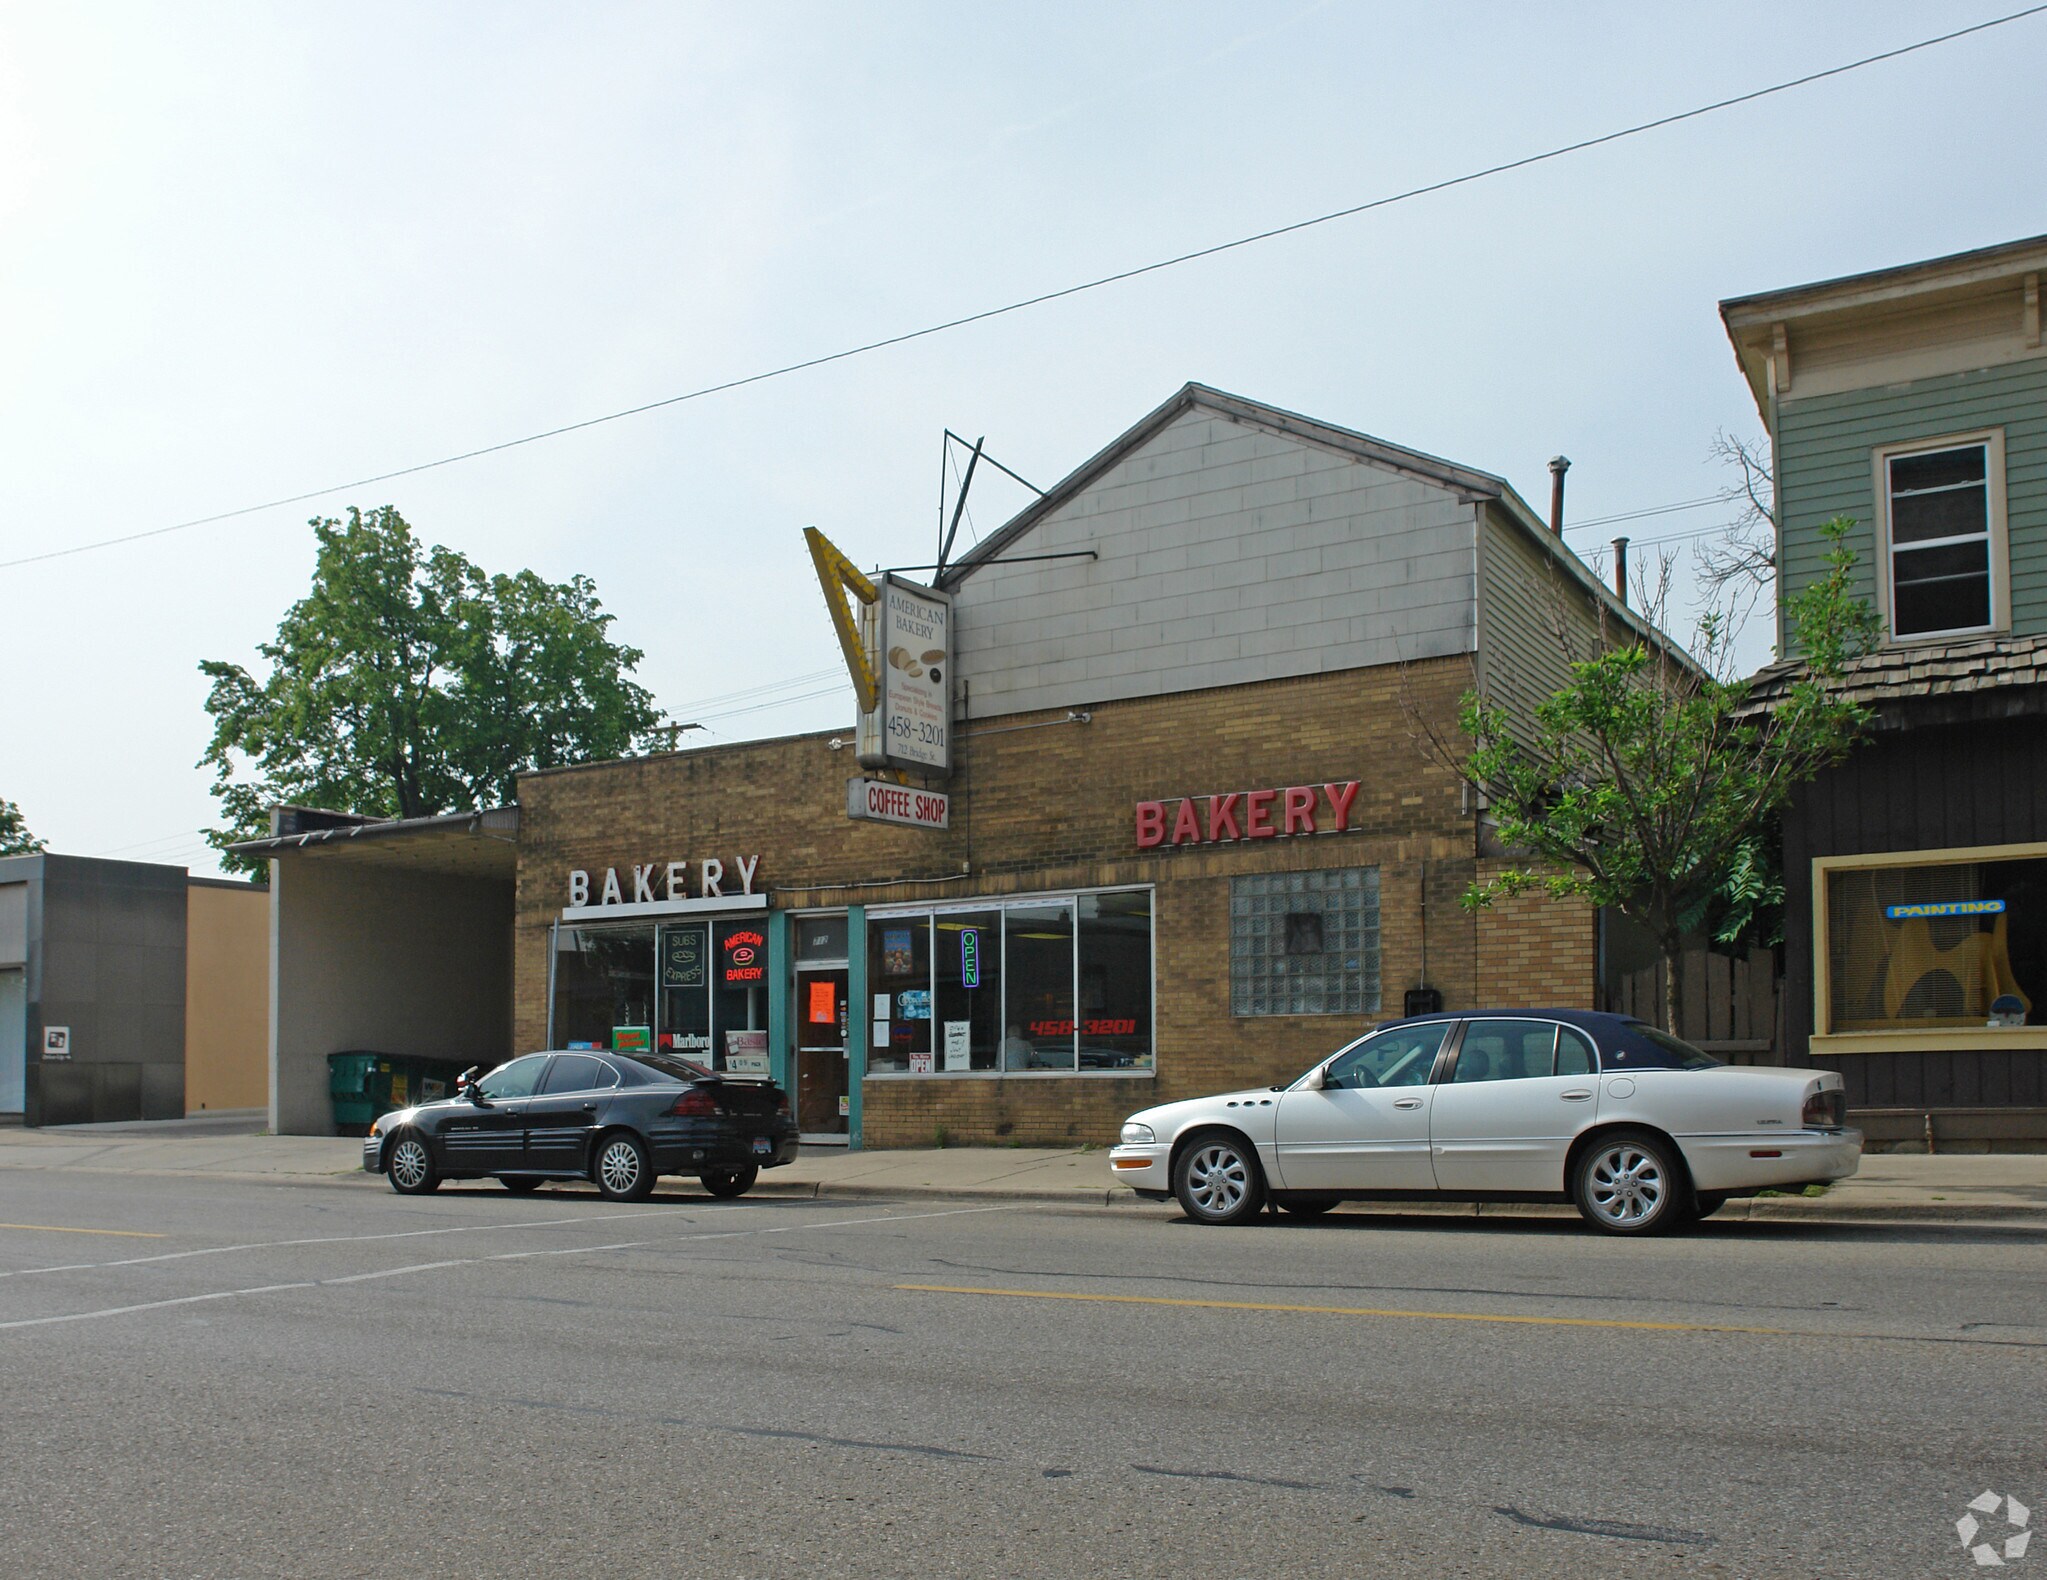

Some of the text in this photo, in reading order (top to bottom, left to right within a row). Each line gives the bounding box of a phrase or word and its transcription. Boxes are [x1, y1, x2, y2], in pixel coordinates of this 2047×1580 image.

[889, 594, 944, 625] AMERICAN
[896, 614, 934, 640] BAKERY
[888, 715, 944, 747] 458-3201
[897, 743, 907, 755] 712
[909, 745, 928, 762] Bridge
[868, 786, 945, 823] COFFEE SHOP
[1136, 780, 1360, 848] BAKERY
[569, 854, 764, 908] BAKERY
[1893, 901, 2002, 917] PAINTING
[672, 934, 697, 947] SUBS
[723, 931, 764, 951] AMERICAN
[963, 932, 977, 985] OPEN
[665, 965, 702, 982] EXPRESS
[726, 967, 763, 981] BAKERY
[1030, 1019, 1136, 1036] 458-3201
[672, 1033, 710, 1049] Marlboro
[911, 1059, 931, 1073] OPEN
